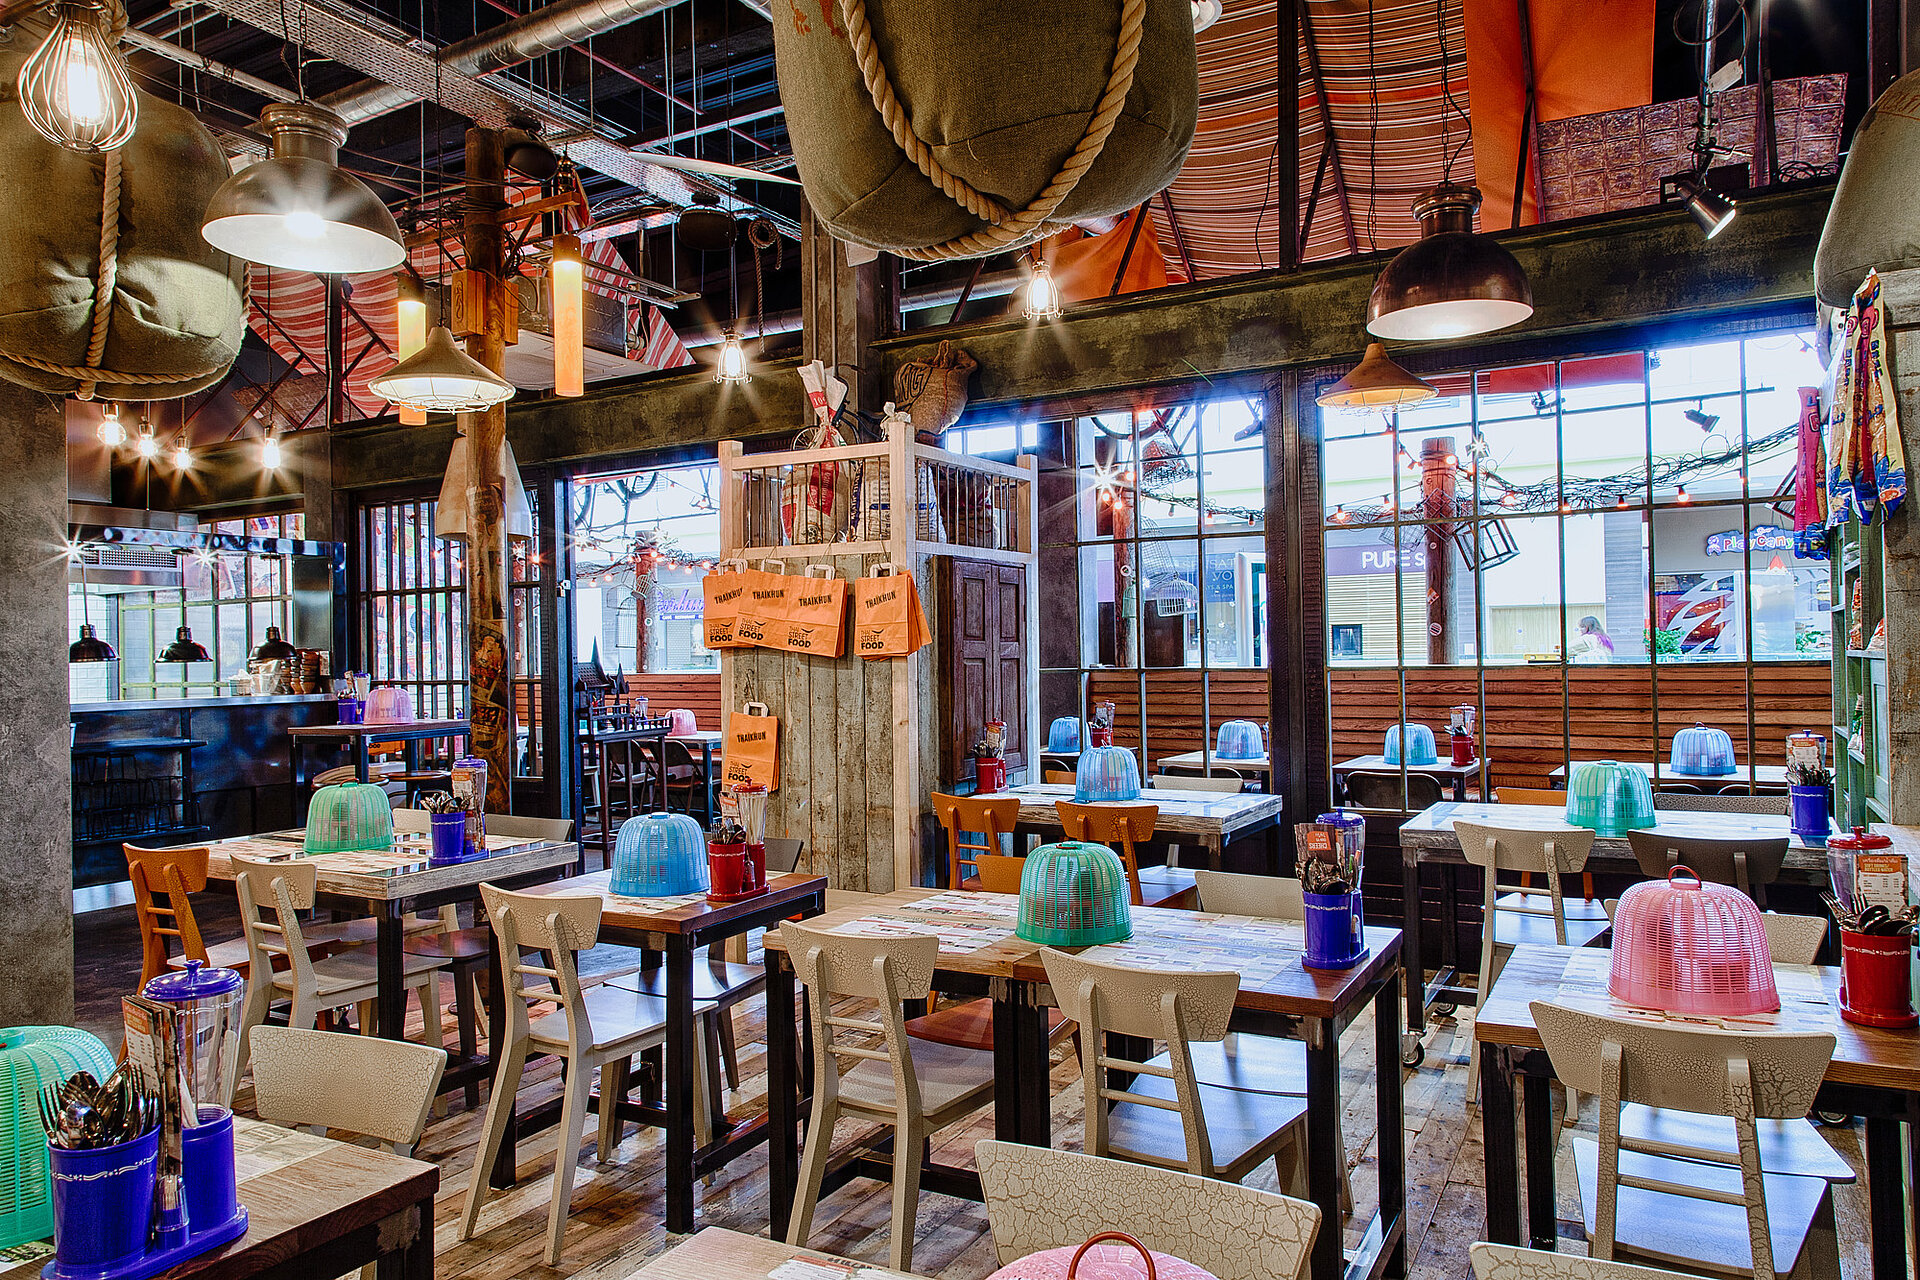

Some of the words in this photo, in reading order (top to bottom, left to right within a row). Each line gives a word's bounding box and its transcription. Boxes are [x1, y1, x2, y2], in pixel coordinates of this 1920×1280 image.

[1362, 549, 1411, 569] PURE
[752, 589, 784, 600] THAIKHUN
[865, 590, 896, 609] THAIKHUN
[798, 594, 832, 607] THAIKHUN
[709, 628, 728, 636] STREET
[739, 623, 760, 633] STREET
[710, 634, 733, 643] FOOD
[738, 629, 763, 641] FOOD
[788, 631, 808, 640] STREET
[860, 635, 880, 643] STREET
[787, 638, 811, 648] FOOD
[860, 641, 884, 650] FOOD
[737, 731, 766, 743] THAIKHUN
[728, 766, 747, 775] STREET
